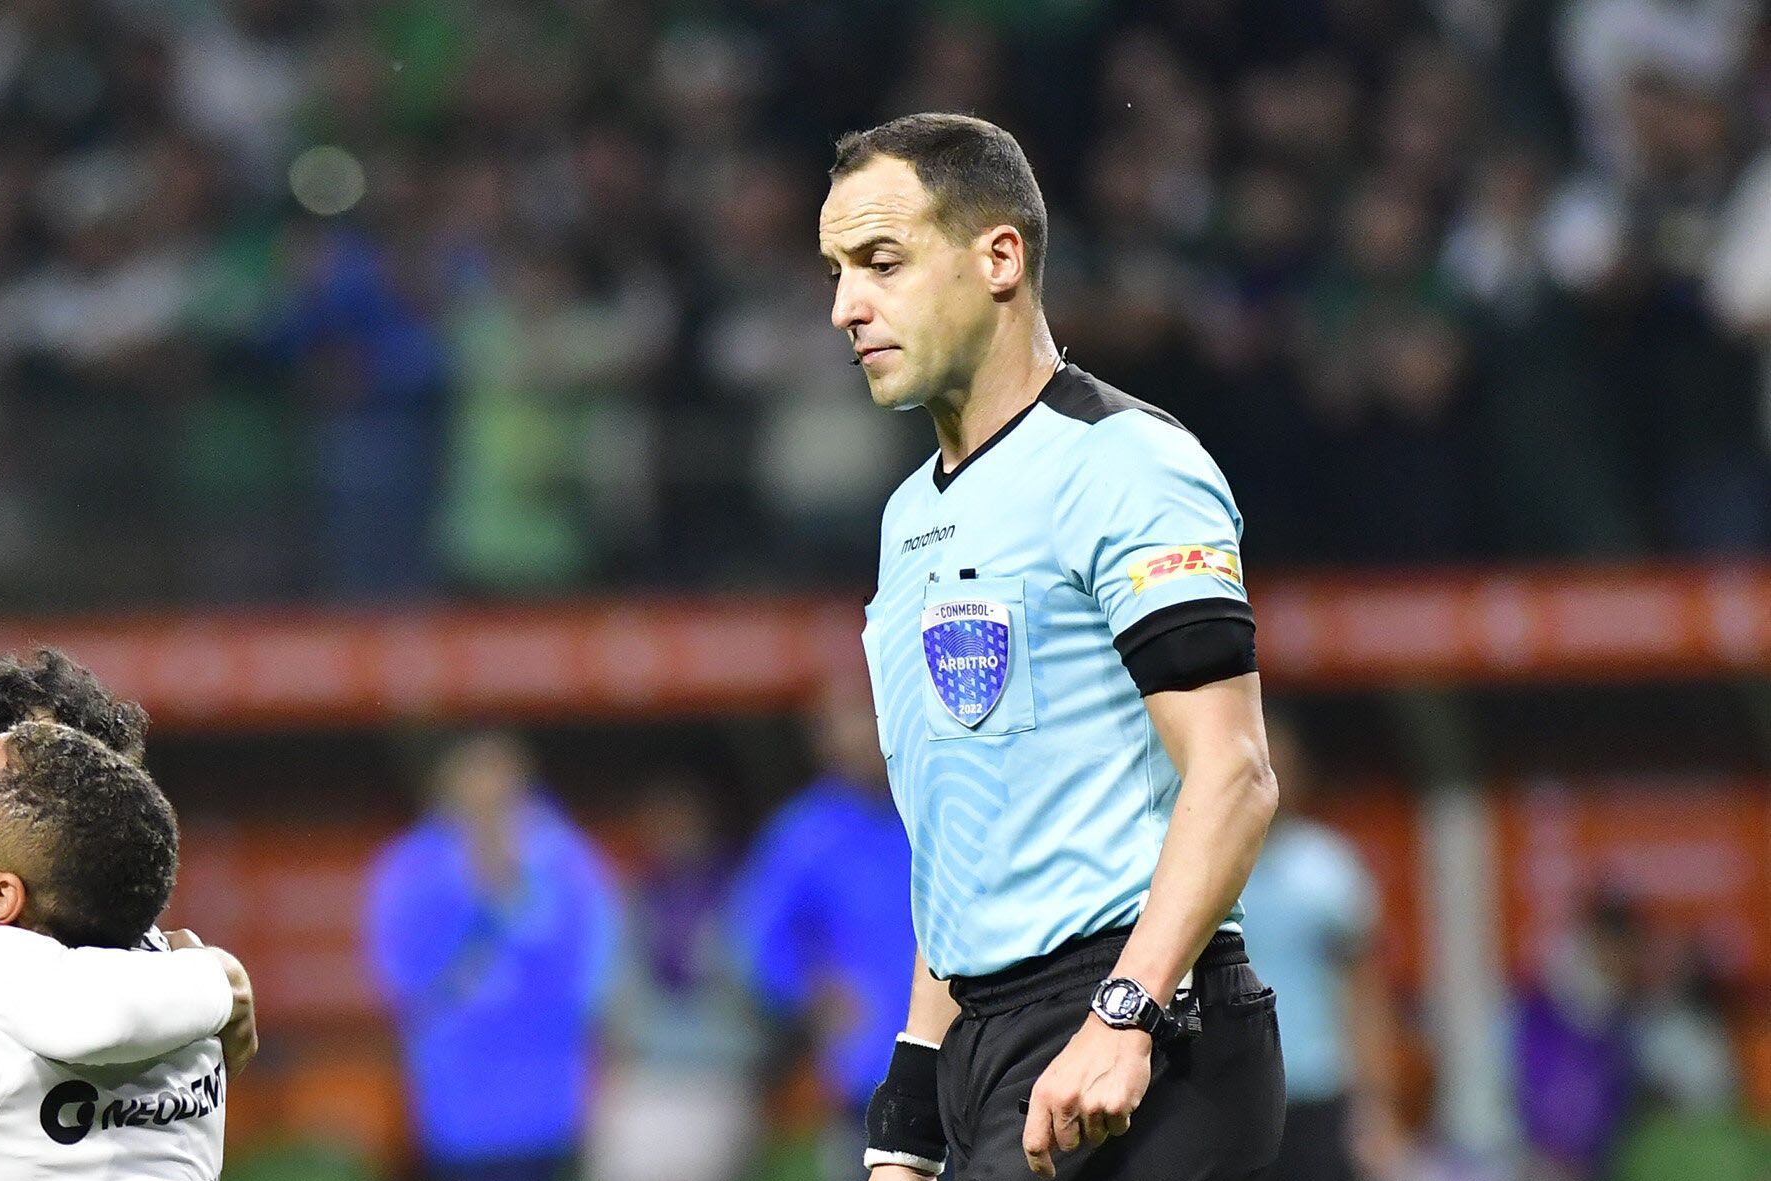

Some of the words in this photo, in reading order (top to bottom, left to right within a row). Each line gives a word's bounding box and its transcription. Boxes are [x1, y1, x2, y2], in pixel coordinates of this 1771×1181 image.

[901, 524, 956, 555] marathon
[938, 654, 999, 673] ÁRBITRO
[958, 703, 983, 715] 2022
